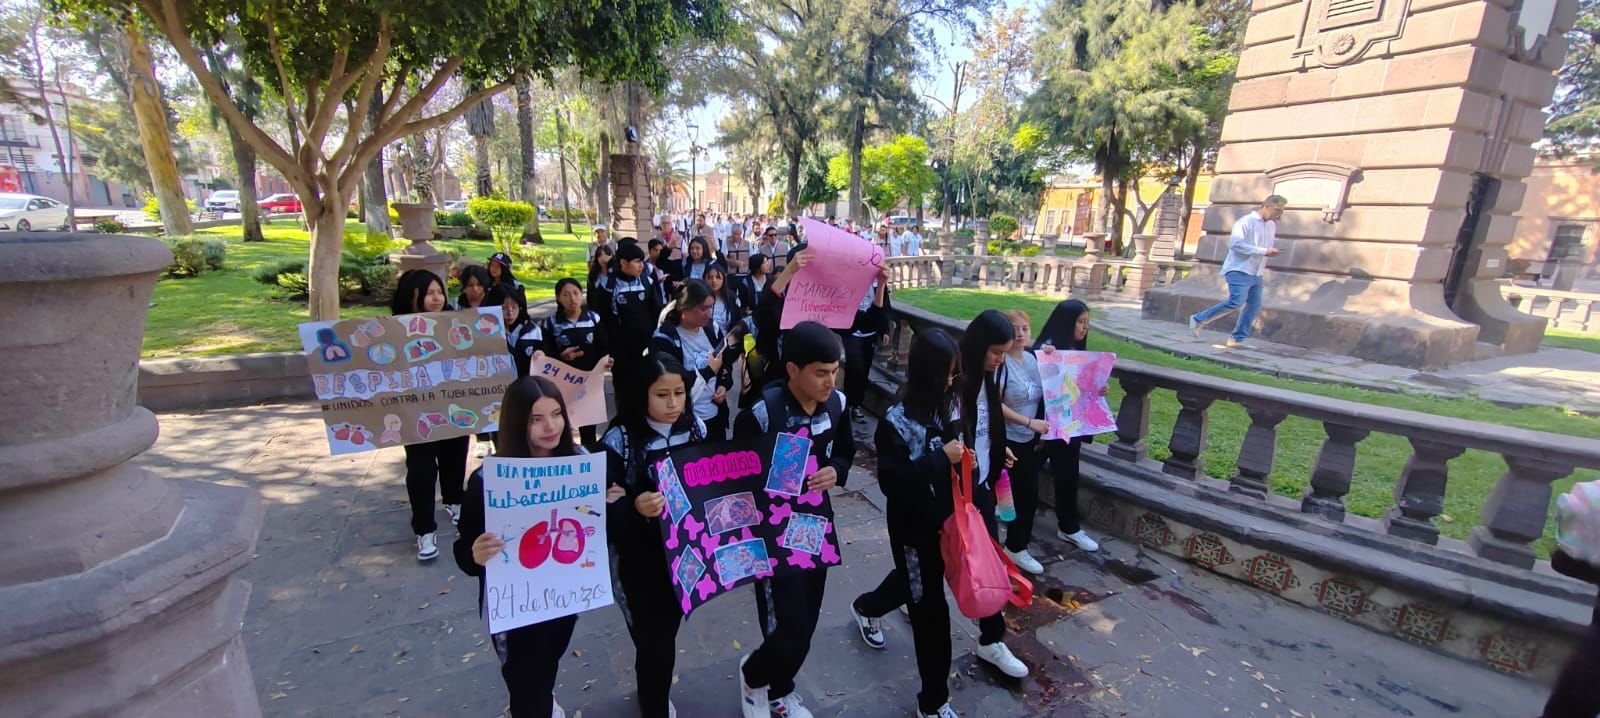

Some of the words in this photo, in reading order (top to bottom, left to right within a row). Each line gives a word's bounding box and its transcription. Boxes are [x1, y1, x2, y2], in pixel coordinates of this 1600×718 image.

[315, 365, 432, 395] RESPIRA
[440, 354, 510, 380] VIDA
[542, 363, 560, 377] 24
[380, 394, 419, 407] CONTRA
[422, 392, 436, 401] LA
[522, 464, 573, 478] MUNDIAL
[524, 479, 541, 490] LA
[486, 483, 600, 509] Tuberculosis
[489, 583, 515, 620] 24
[520, 580, 540, 613] de
[543, 584, 607, 609] Marzo
